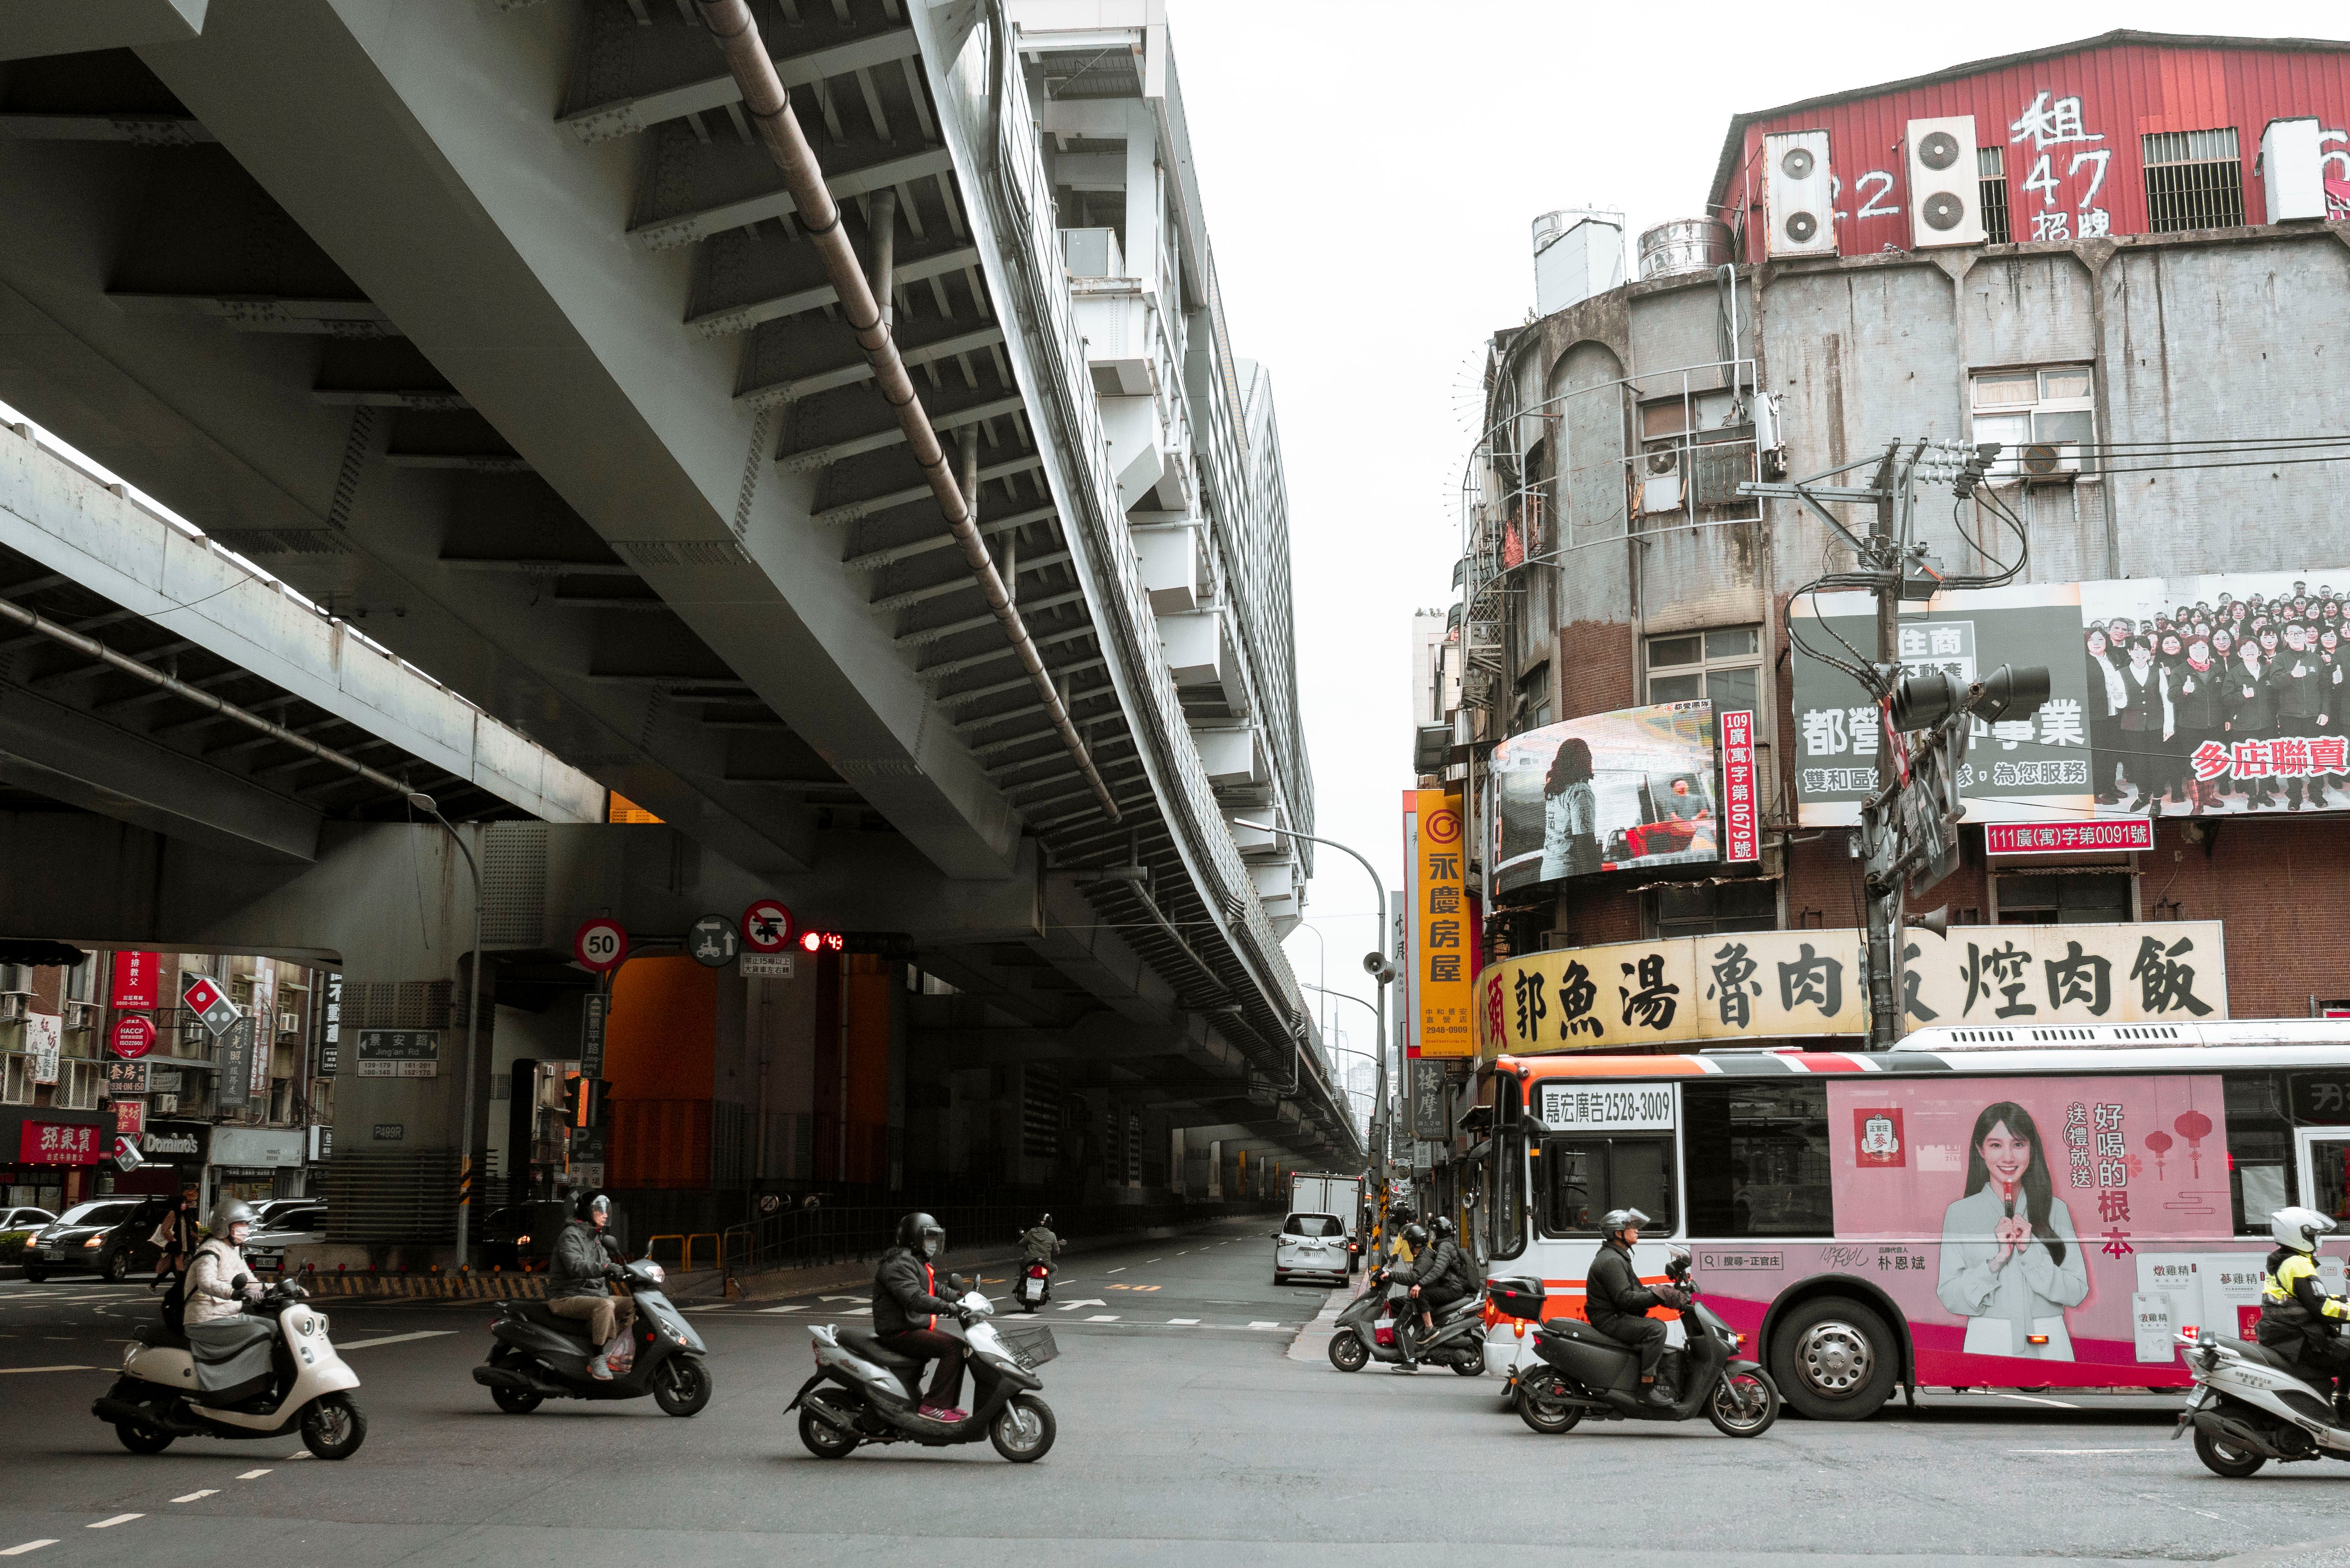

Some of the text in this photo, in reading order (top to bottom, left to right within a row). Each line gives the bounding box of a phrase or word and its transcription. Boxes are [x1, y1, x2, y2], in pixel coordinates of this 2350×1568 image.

[2022, 148, 2111, 208] 47
[1990, 824, 2148, 849] 111廣(寓)字第0091號
[1429, 852, 1461, 982] 永慶房屋
[588, 935, 614, 954] 50
[370, 1034, 428, 1046] 景安路
[588, 1018, 600, 1054] 景平路
[110, 1063, 136, 1080] 套房
[138, 1065, 144, 1082] 出租
[1417, 1066, 1440, 1120] 按摩
[1546, 1091, 1670, 1123] 嘉宏廣告2528-3009
[41, 1126, 91, 1153] 孫東寶
[375, 1126, 401, 1137] P499R
[572, 1128, 590, 1150] P
[143, 1133, 198, 1153] Domino's
[2066, 1102, 2092, 1188] 送禮就送
[47, 1153, 83, 1161] 台式牛排教父
[572, 1166, 599, 1175] 中安
[2094, 1102, 2134, 1260] 好喝的根本
[570, 1177, 601, 1186] 停車場
[1878, 1256, 1926, 1270] 朴恩斌
